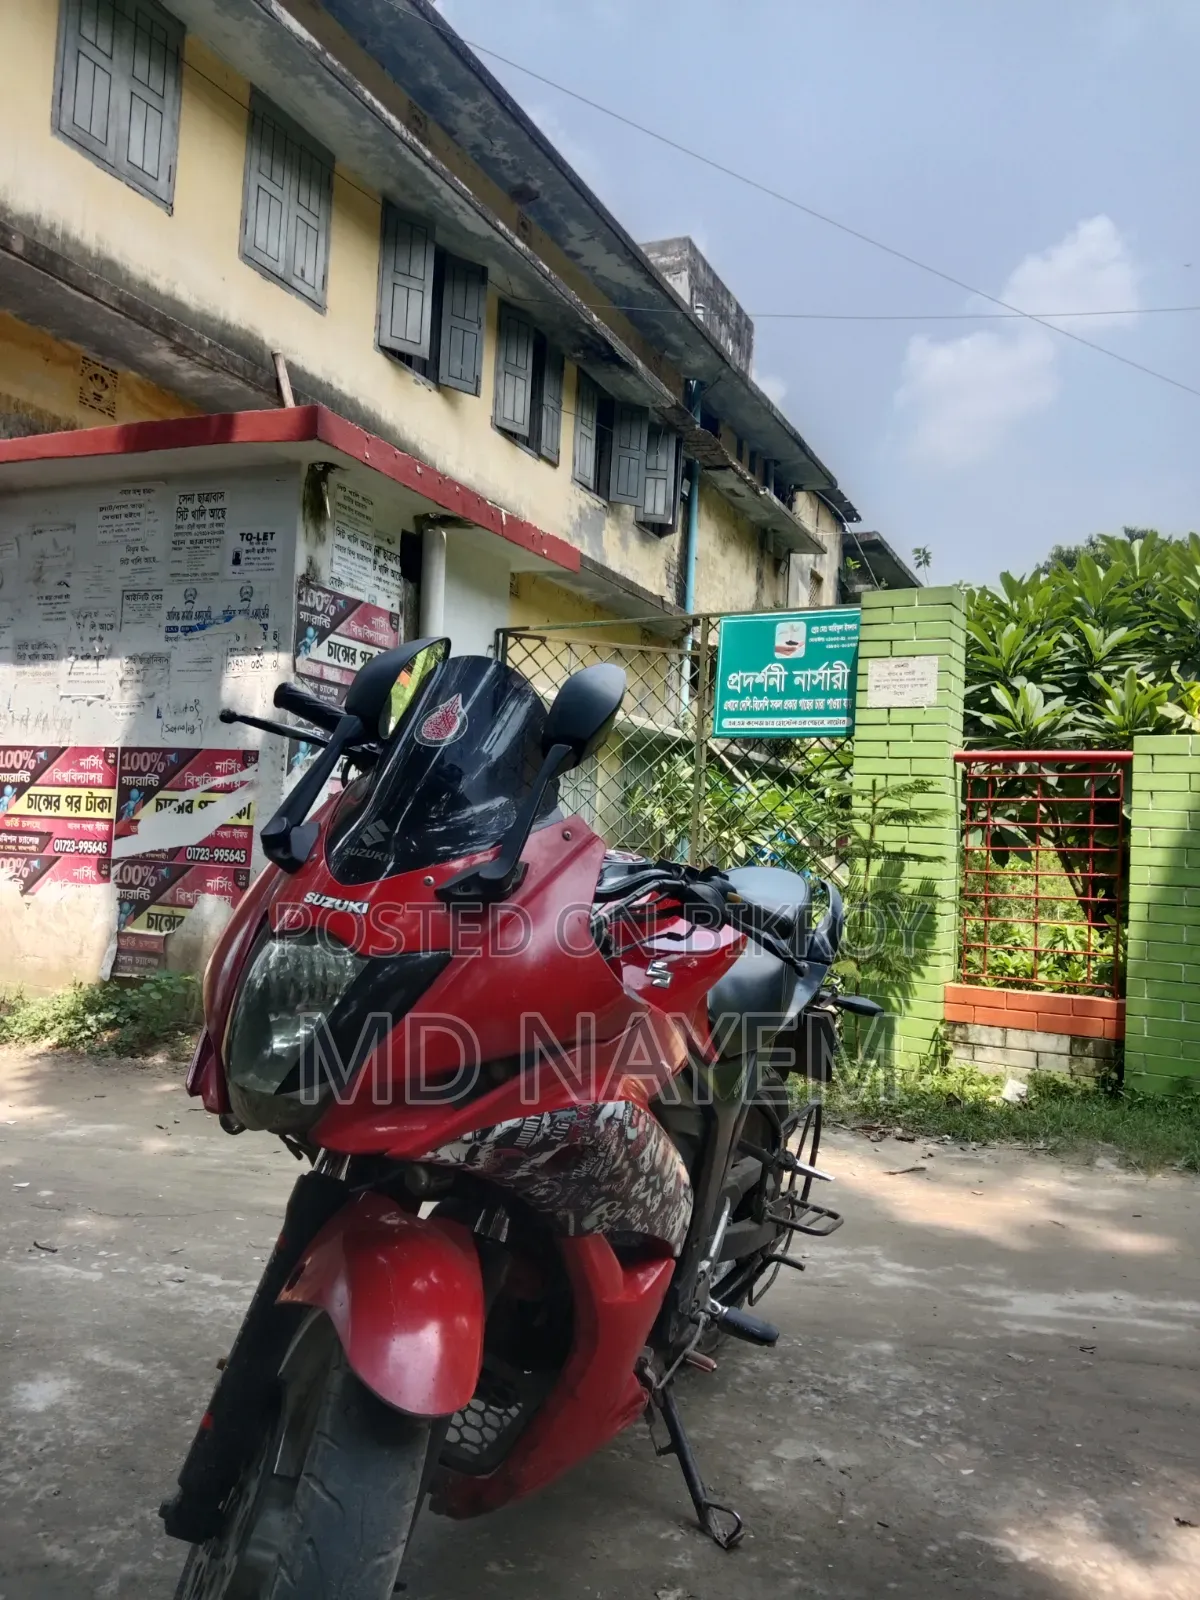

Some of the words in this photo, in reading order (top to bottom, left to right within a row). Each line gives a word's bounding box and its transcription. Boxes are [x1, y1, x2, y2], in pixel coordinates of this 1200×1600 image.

[197, 491, 225, 504] ছাত্রাবাস
[176, 506, 189, 522] সিট
[191, 504, 206, 520] খালি
[208, 507, 227, 520] আছে
[239, 531, 276, 542] TO-LET
[300, 610, 332, 628] গ্যারান্টি
[327, 641, 358, 665] চান্সের
[727, 663, 788, 694] প্রদর্শনী
[792, 660, 851, 692] নার্সারী
[79, 755, 104, 770] নার্সিং
[121, 752, 165, 773] 100%
[215, 758, 241, 774] নার্সিং
[0, 770, 30, 783] ্যারান্টি
[53, 768, 104, 784] বিশ্ববিদ্যালয়
[122, 773, 160, 786] গ্যারান্টি
[27, 793, 61, 812] চান্সের
[65, 795, 82, 813] পর
[85, 792, 112, 813] টাকা
[53, 839, 108, 854] 01723-995645
[186, 847, 246, 862] 01723-995645
[343, 847, 388, 861] SUZUKI
[0, 858, 30, 878] 00%
[72, 866, 96, 881] নার্সিং
[206, 876, 232, 892] নার্সিং
[118, 887, 151, 900] ্যারান্টি
[303, 891, 369, 914] SUZUKI
